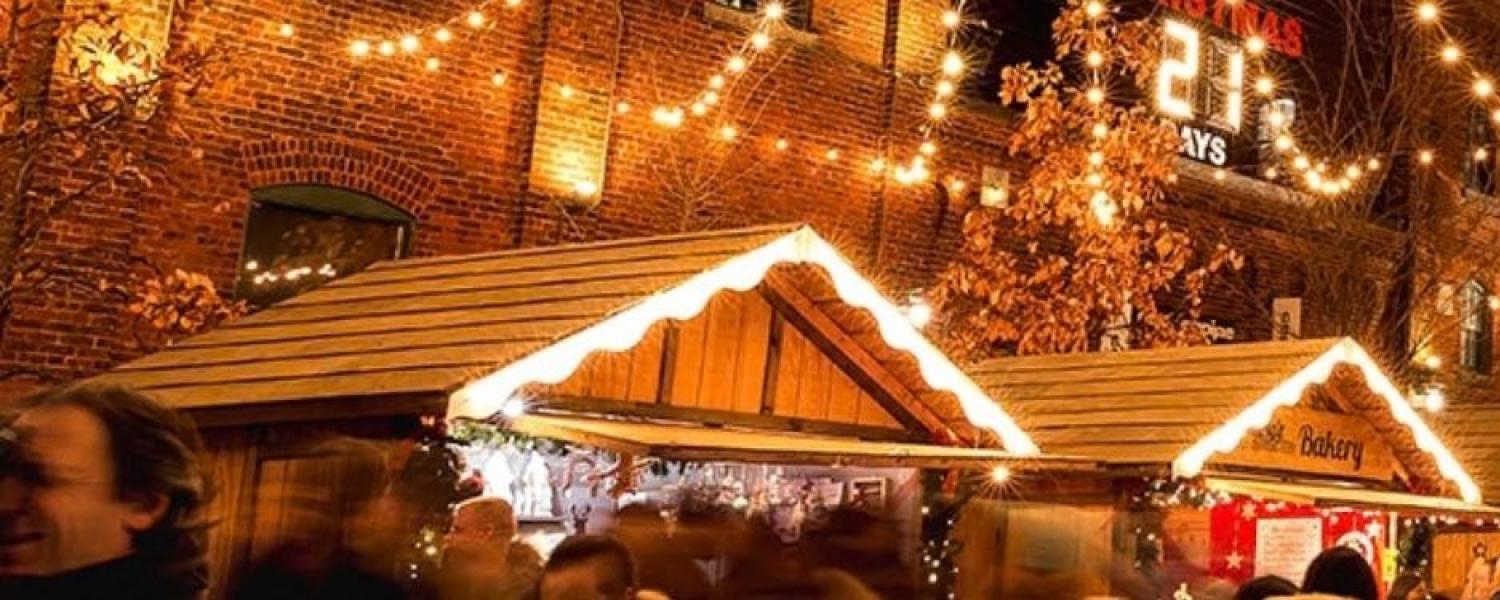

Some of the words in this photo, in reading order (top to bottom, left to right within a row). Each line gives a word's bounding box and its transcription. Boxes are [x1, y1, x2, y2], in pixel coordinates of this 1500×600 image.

[1155, 19, 1243, 135] 21
[1180, 125, 1227, 166] AYS
[1300, 424, 1364, 471] Bakery
